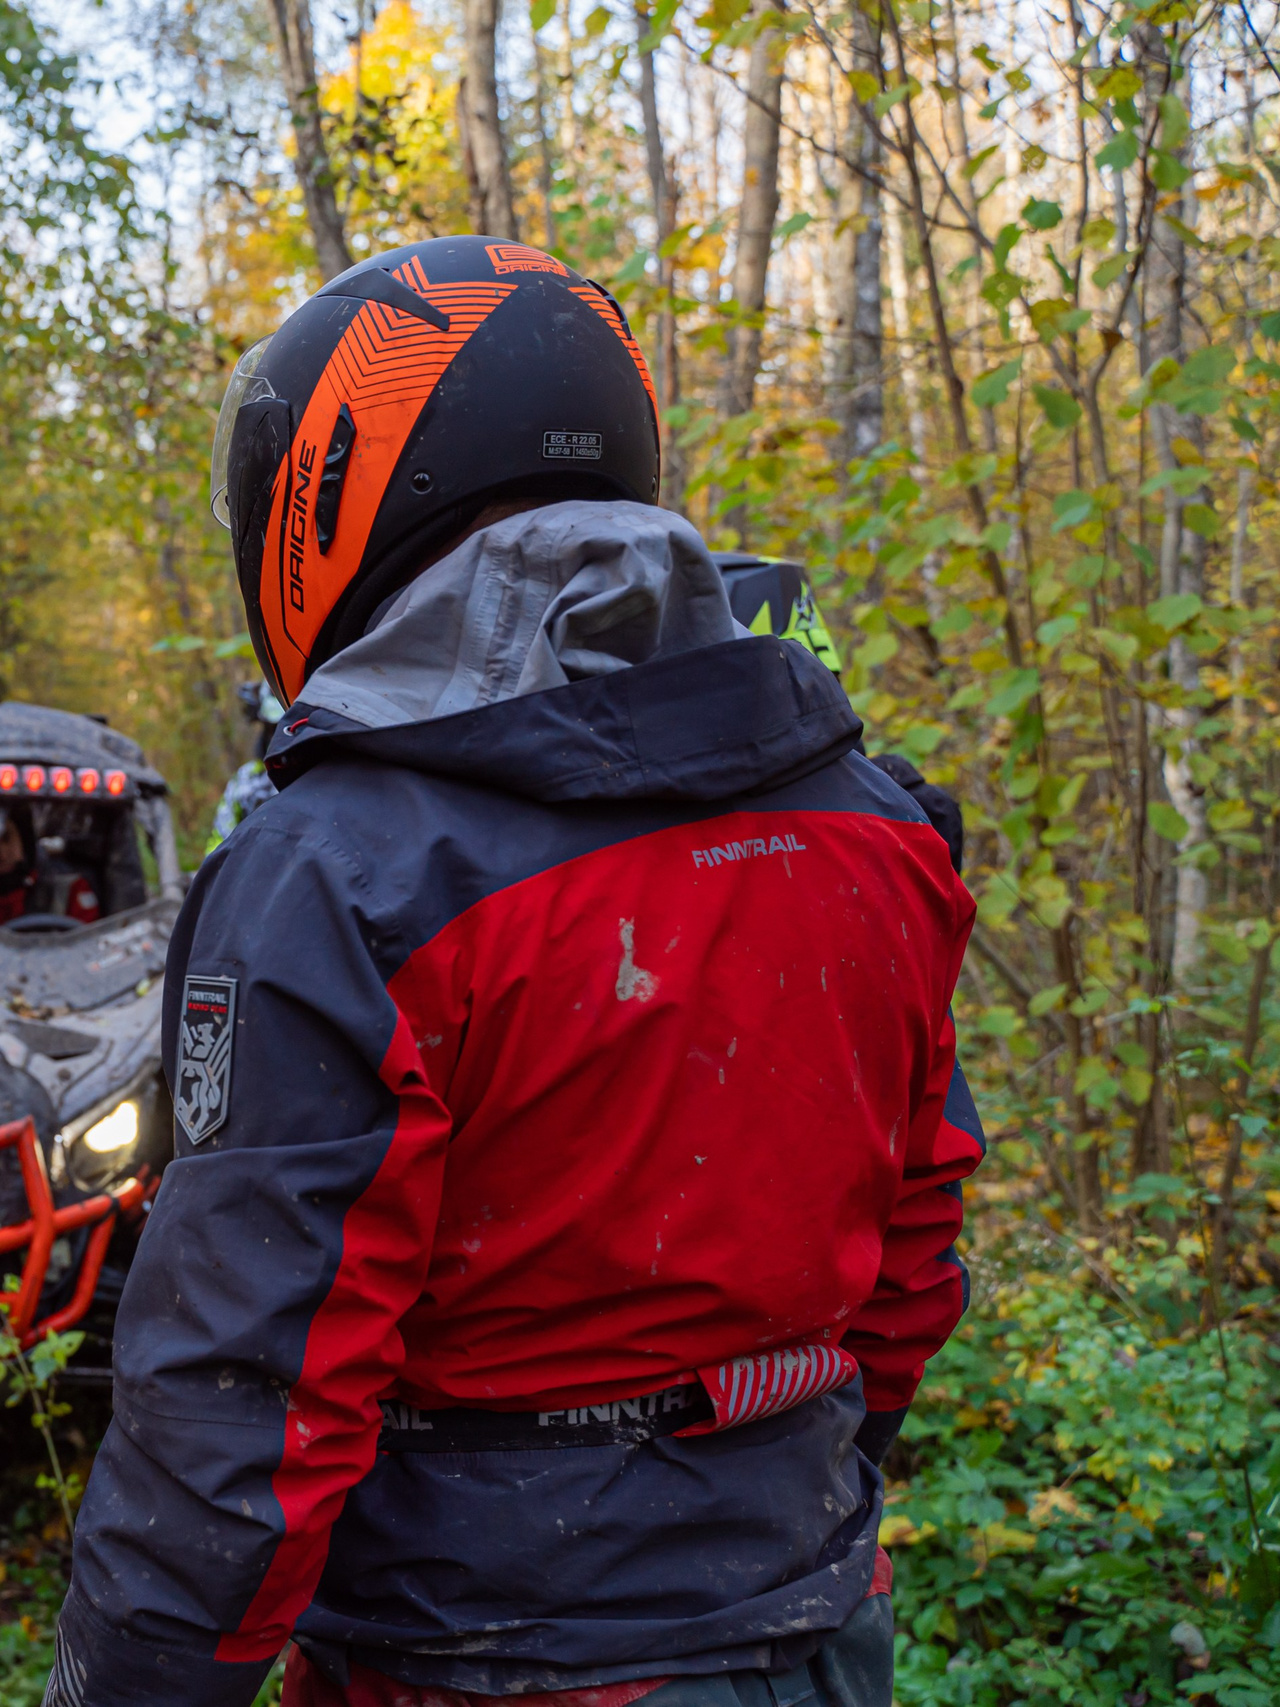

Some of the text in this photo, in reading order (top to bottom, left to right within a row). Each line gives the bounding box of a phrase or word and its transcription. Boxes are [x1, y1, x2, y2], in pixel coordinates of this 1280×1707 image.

[550, 434, 567, 444] ECE
[571, 435, 579, 445] R
[579, 436, 597, 445] 22.05
[289, 438, 318, 614] ORIGINE
[691, 833, 807, 869] FINNTRAIL
[188, 990, 228, 1004] FINNTRAIL
